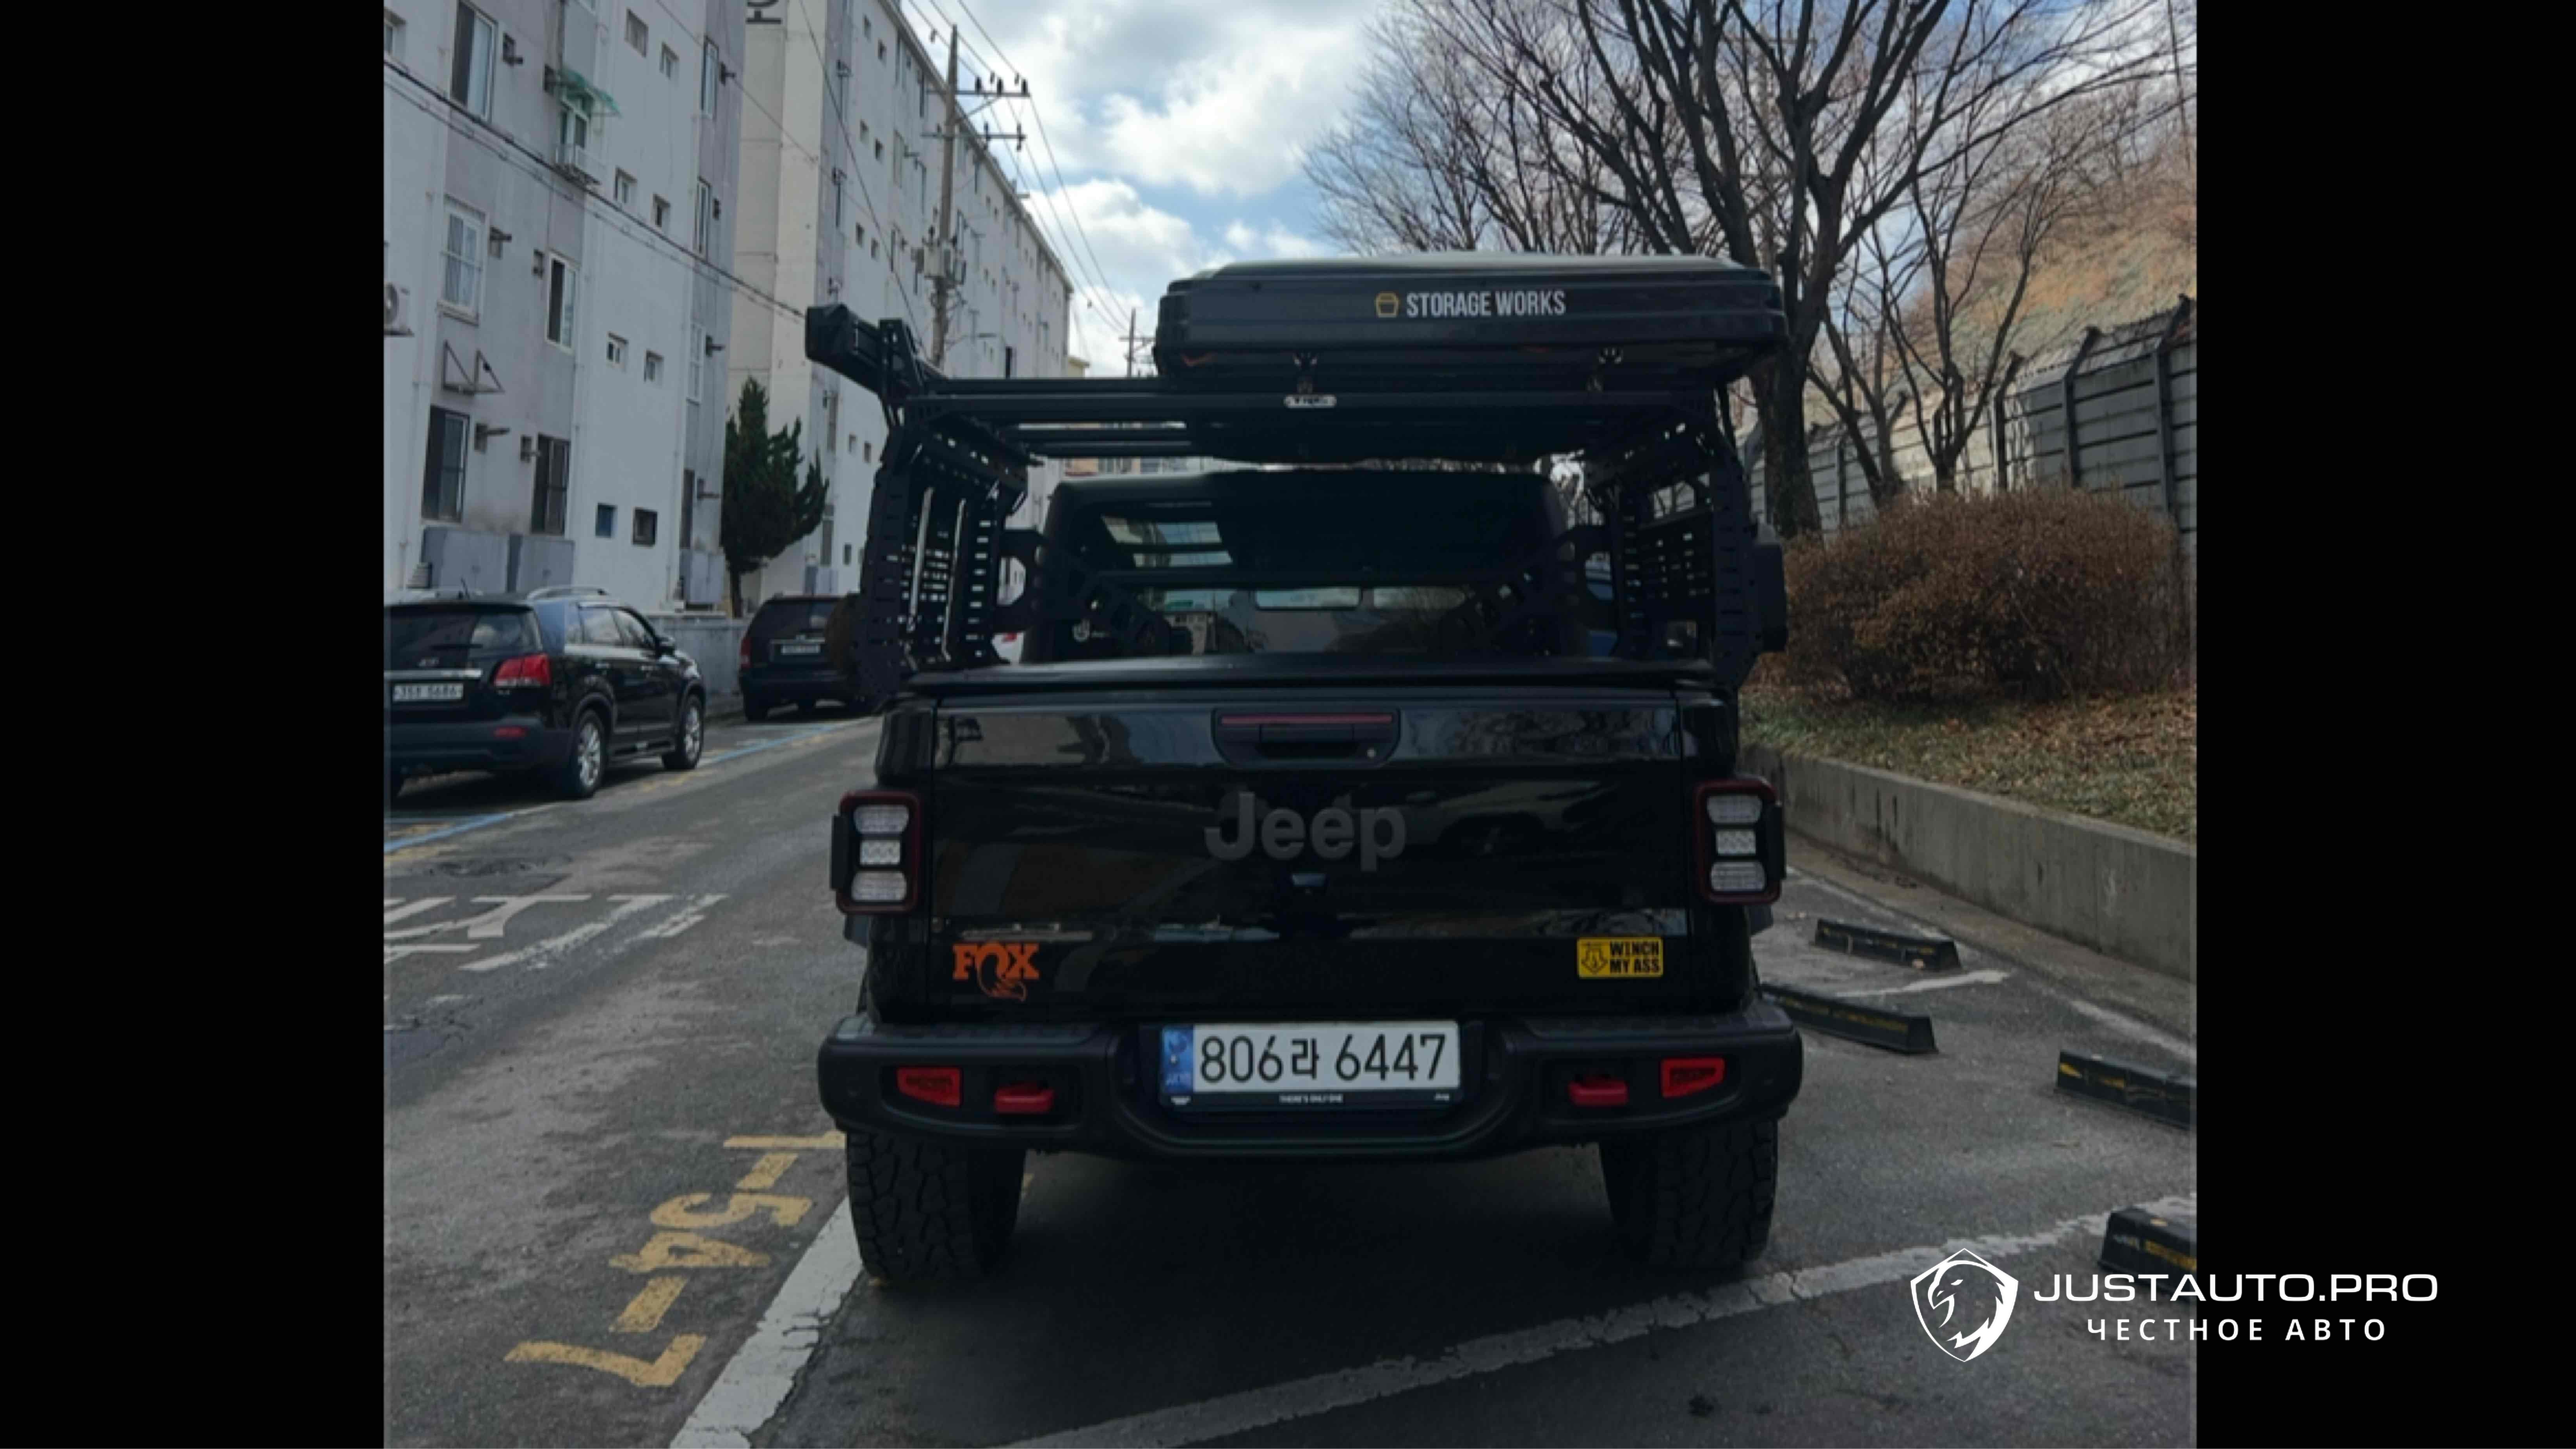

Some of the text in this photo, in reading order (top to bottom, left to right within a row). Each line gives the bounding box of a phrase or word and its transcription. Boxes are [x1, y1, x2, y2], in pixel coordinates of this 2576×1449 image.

[1406, 290, 1566, 317] STORAGE WORKS
[1204, 792, 1406, 872] Jeep
[952, 939, 1039, 980] FOX
[1610, 941, 1659, 956] WINCH
[1610, 958, 1661, 973] MY ASS
[1200, 1033, 1446, 1083] 806라 6447
